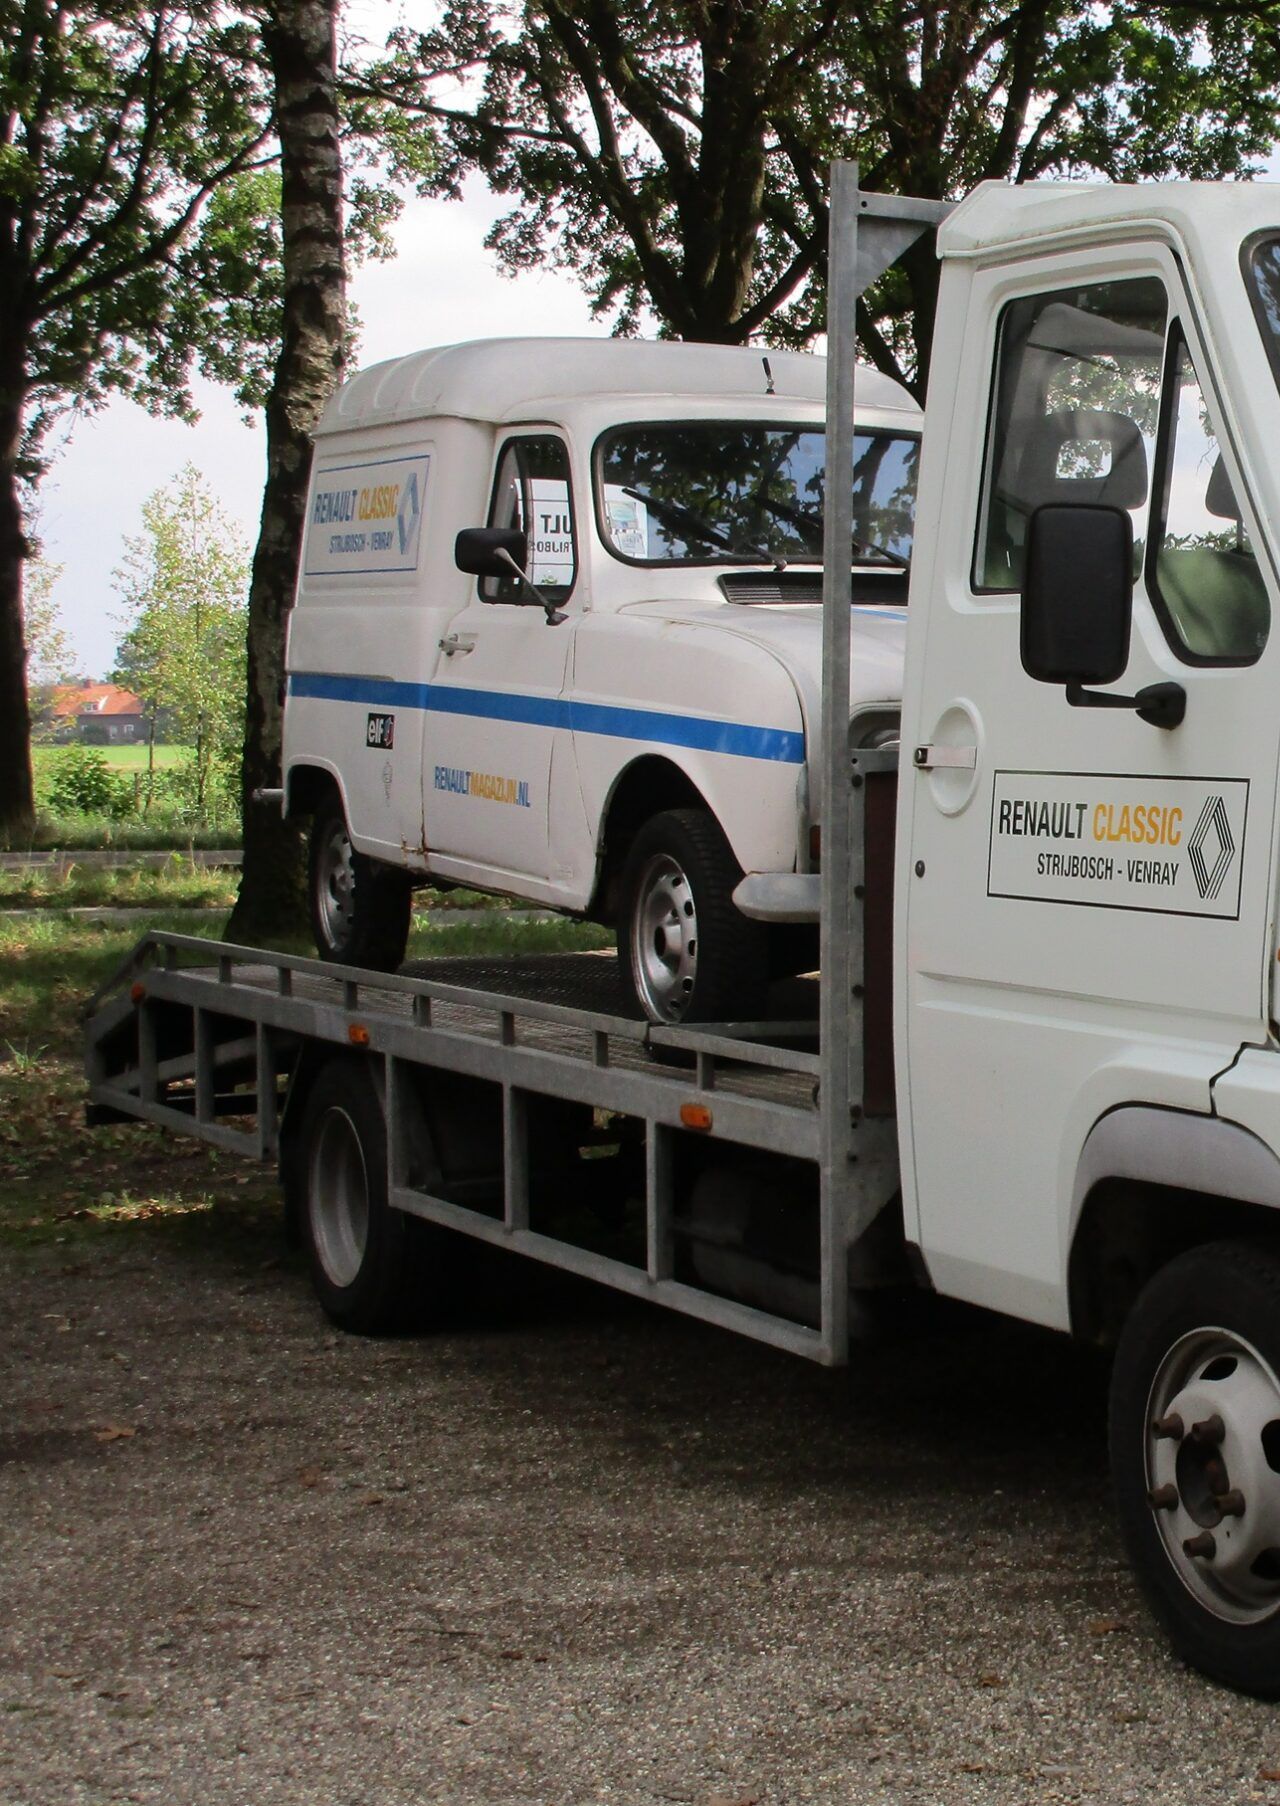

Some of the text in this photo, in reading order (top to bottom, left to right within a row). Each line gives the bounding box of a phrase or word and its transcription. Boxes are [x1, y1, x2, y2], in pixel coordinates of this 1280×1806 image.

[314, 484, 399, 524] RENAULT CLASSIC
[368, 718, 384, 743] elf
[434, 766, 531, 807] RENAULTMAGAZIJN.NL
[999, 800, 1183, 846] RENAULT CLASSIC
[1037, 853, 1113, 880] STRIJBOSCH
[1127, 860, 1179, 886] VENRAY
